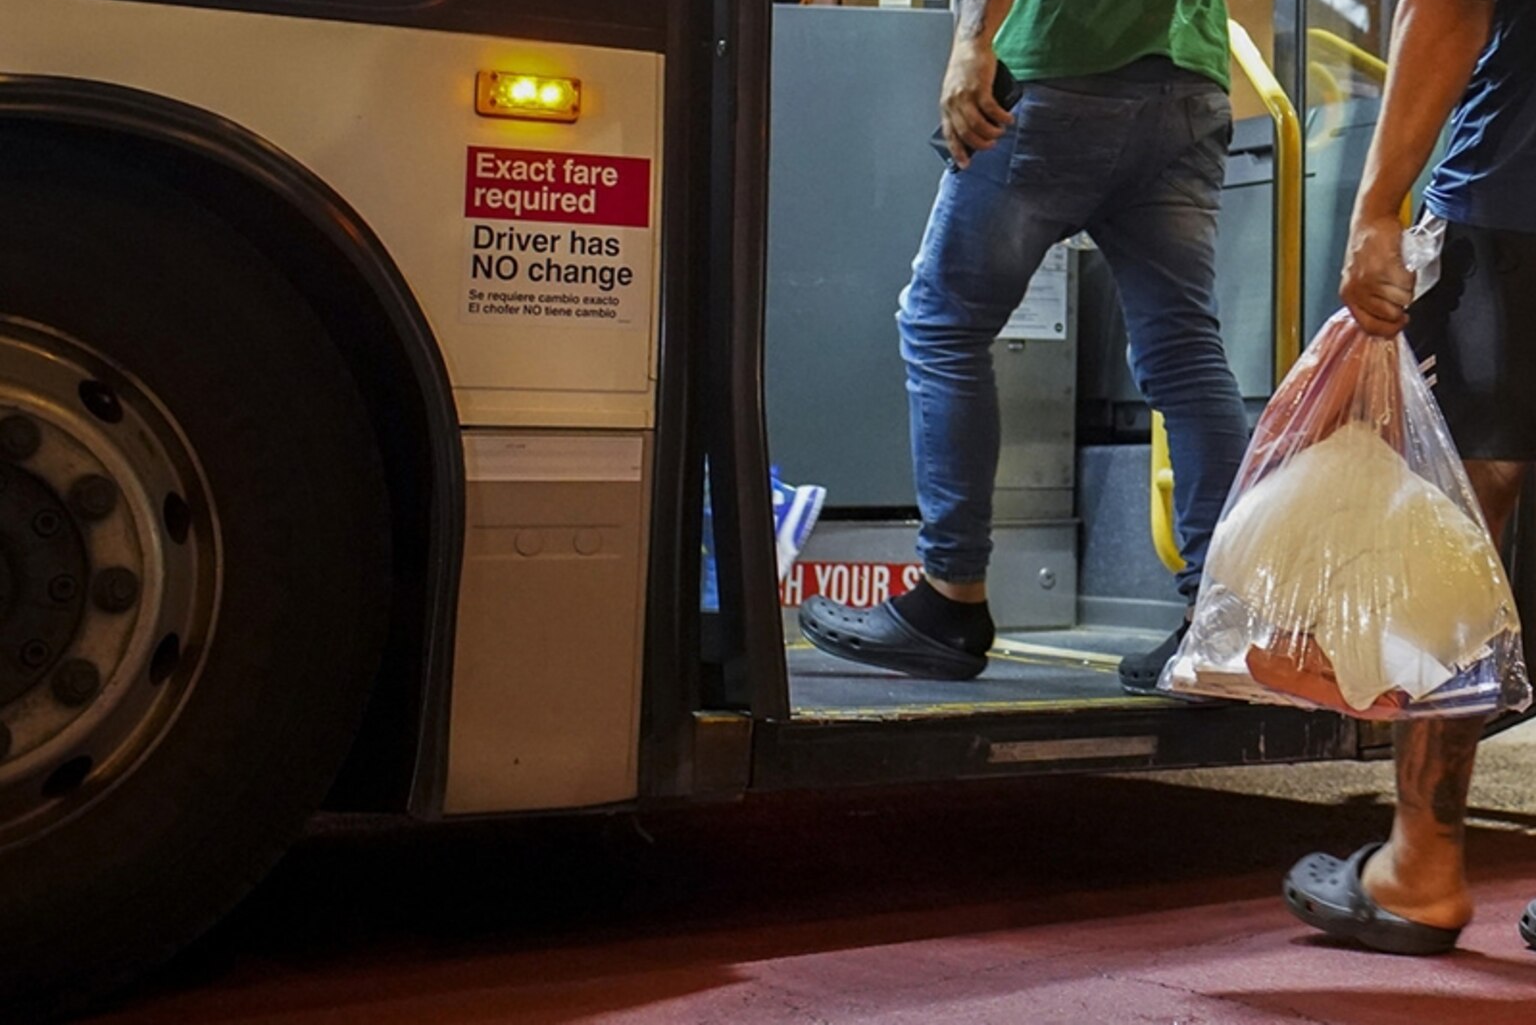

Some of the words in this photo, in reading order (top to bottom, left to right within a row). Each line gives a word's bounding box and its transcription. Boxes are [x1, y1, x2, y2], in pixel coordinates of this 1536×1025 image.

[475, 152, 556, 183] Exact
[563, 159, 618, 187] fare
[474, 186, 596, 216] required
[473, 225, 561, 253] Driver
[570, 230, 620, 257] has
[471, 254, 518, 281] NO
[528, 258, 634, 291] change
[468, 289, 485, 301] Se
[487, 291, 536, 304] requiere
[538, 292, 581, 305] cambio
[582, 295, 620, 307] exacto
[468, 303, 480, 314] El
[483, 303, 521, 315] chofer
[523, 305, 543, 316] NO
[544, 306, 573, 317] tiene
[575, 307, 617, 319] cambio
[814, 564, 891, 607] YOUR
